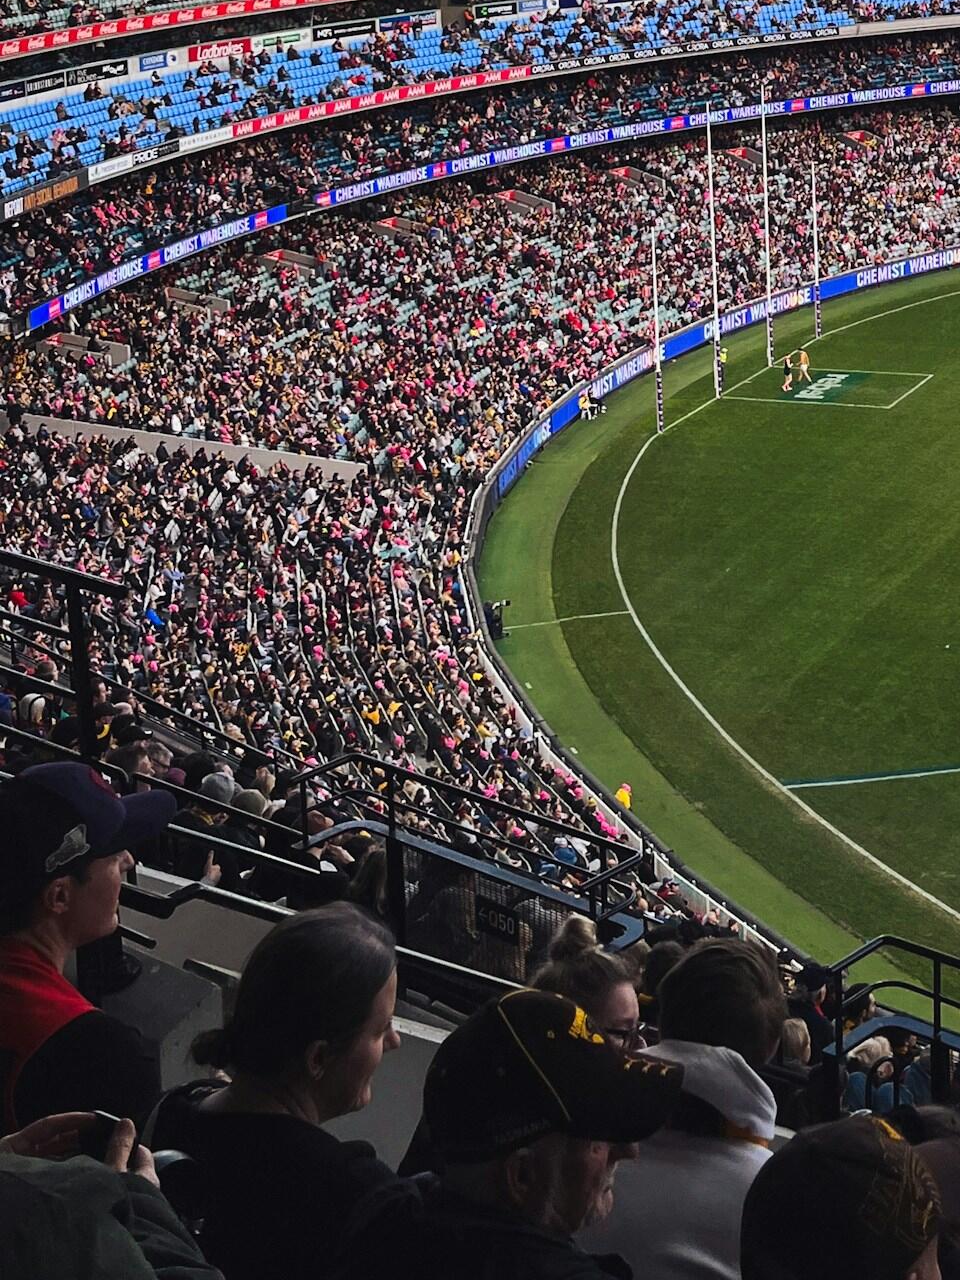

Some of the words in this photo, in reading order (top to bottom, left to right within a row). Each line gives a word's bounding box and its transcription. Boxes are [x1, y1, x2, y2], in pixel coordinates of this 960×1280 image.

[196, 42, 244, 60] Ladbrokes
[809, 92, 849, 108] CHEMIST
[851, 86, 906, 103] WAREHOUSE
[570, 129, 609, 147] CHEMIST
[611, 119, 665, 143] WAREHOUSE
[133, 148, 158, 164] PRIDE
[452, 152, 491, 173] CHEMIST
[493, 140, 546, 163] WAREHOUSE
[335, 179, 374, 202] CHEMIST
[376, 165, 428, 191] WAREHOUSE
[164, 234, 199, 261] CHEMIST
[200, 218, 250, 247] WAREHOUSE
[64, 279, 96, 310] CHEMIST
[98, 257, 143, 293] WAREHOUSE
[857, 261, 906, 287] CHEMIST
[616, 345, 665, 386] WAREHOUE
